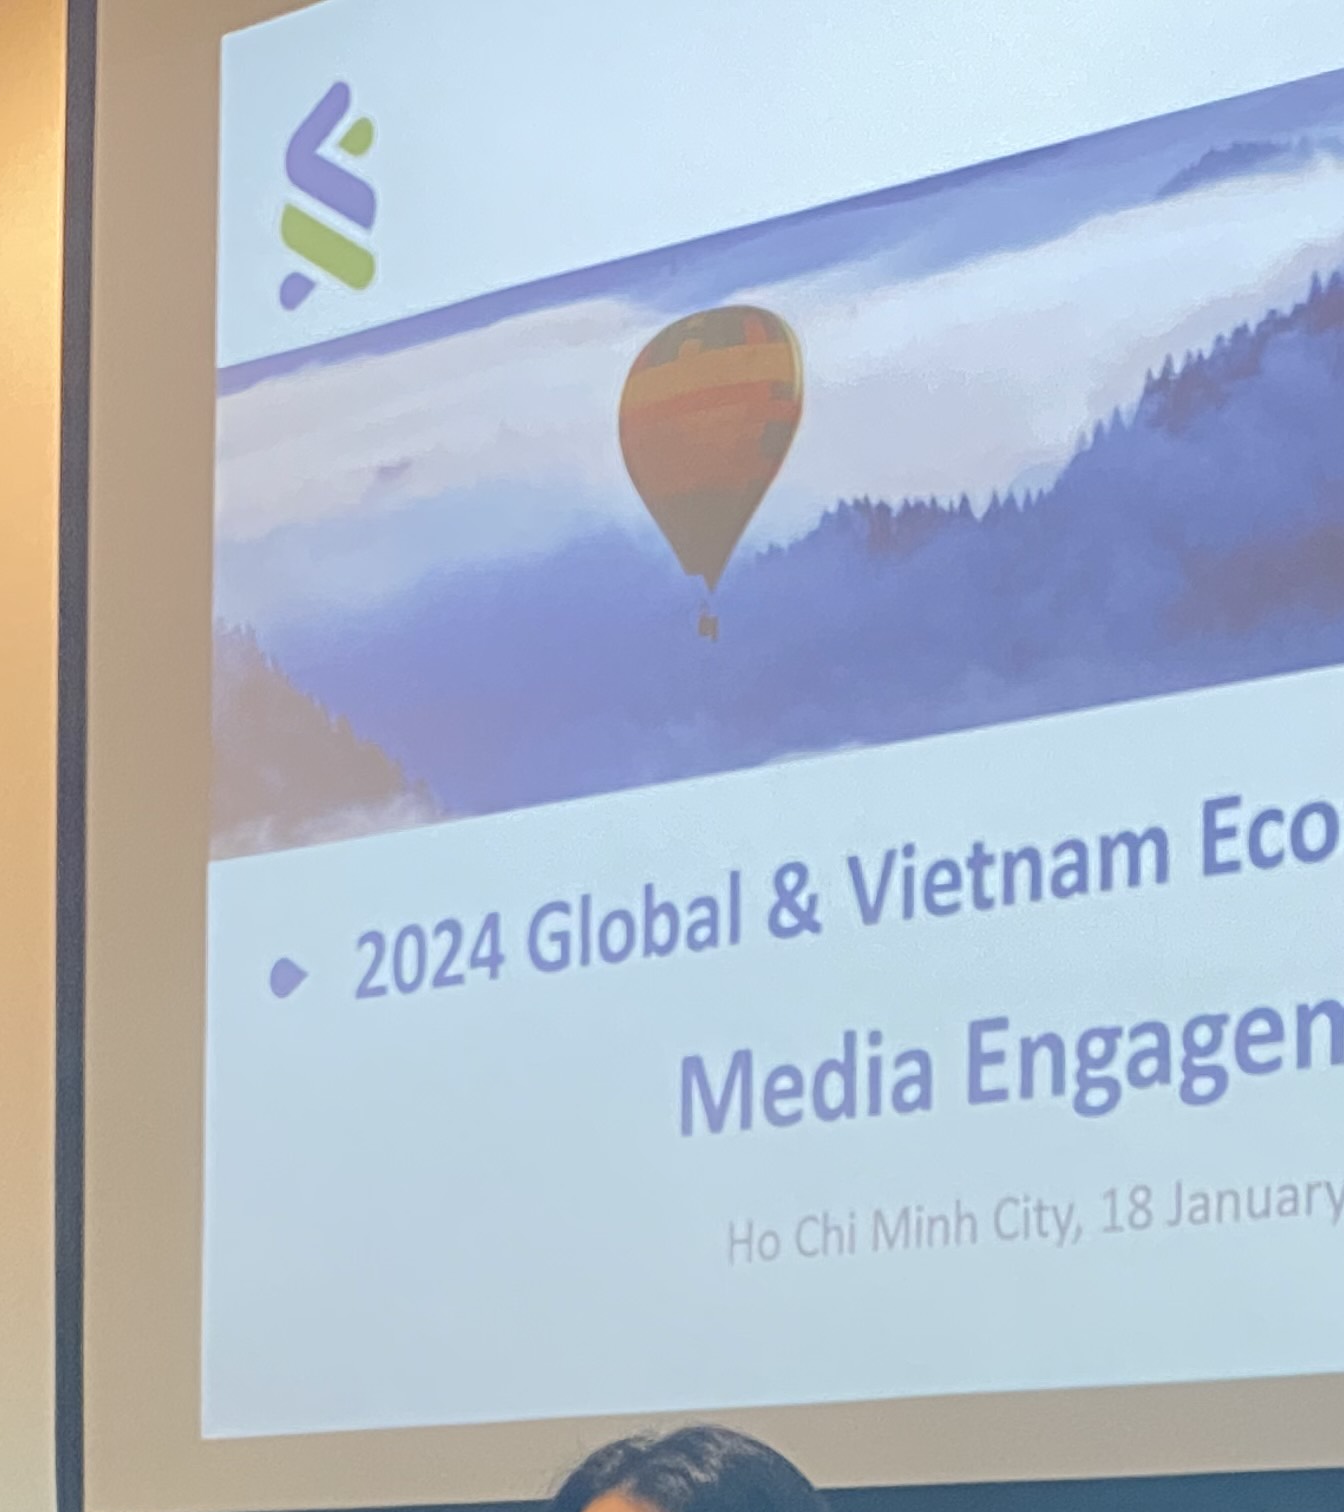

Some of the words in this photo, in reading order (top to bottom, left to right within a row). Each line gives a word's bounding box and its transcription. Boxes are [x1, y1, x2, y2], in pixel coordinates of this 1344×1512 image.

[354, 911, 504, 999] 2024
[527, 870, 742, 975] Global
[766, 861, 822, 939] &
[847, 824, 1169, 926] Vietnam
[679, 1029, 933, 1137] Media
[727, 1219, 781, 1265] Ho
[794, 1212, 856, 1259] Chi
[871, 1200, 977, 1251] Minh
[993, 1192, 1083, 1249] City,
[1101, 1187, 1152, 1235] 18
